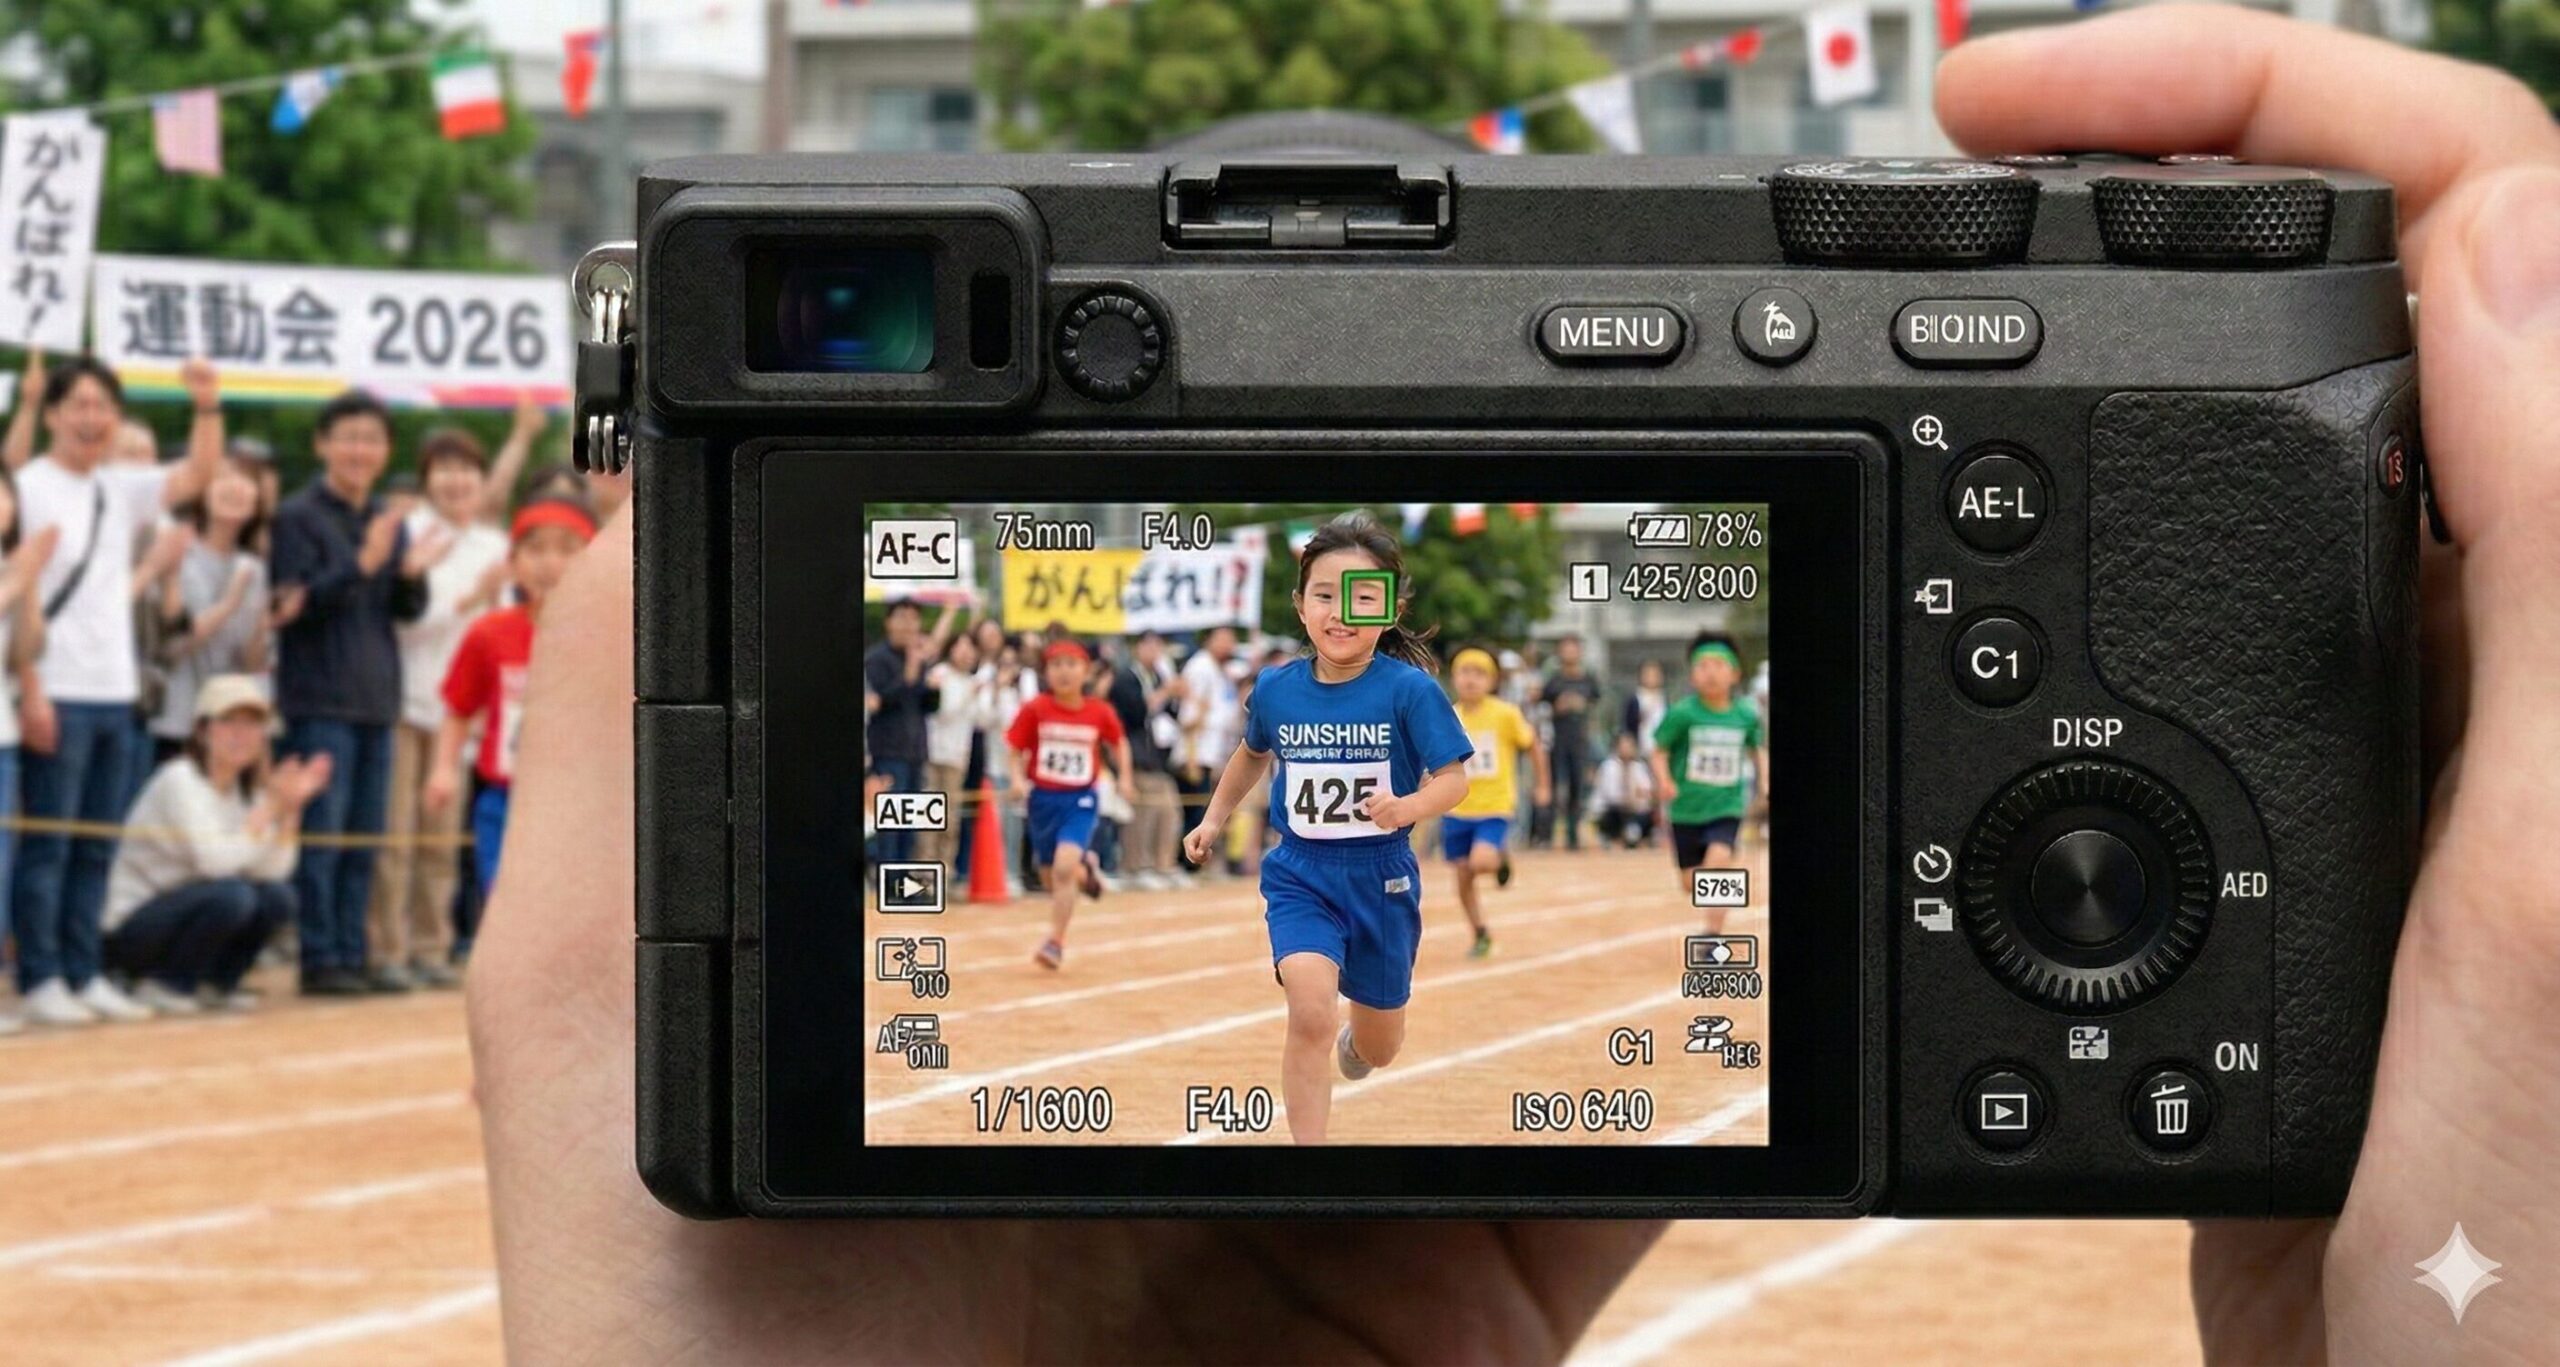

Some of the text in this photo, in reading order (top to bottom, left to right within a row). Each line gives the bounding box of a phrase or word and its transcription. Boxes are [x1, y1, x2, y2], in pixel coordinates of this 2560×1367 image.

[121, 278, 546, 369] 運動会 2026
[1560, 317, 1665, 347] MENU
[1958, 486, 2036, 519] AE-L
[994, 513, 1094, 549] 75mm
[1142, 513, 1213, 549] F4.0
[1697, 512, 1762, 548] 78%
[876, 532, 951, 565] AF-C
[1583, 564, 1758, 600] 1 425/800
[1971, 646, 2019, 680] C1
[1278, 722, 1392, 746] SUNSHINE
[2053, 718, 2123, 748] DISP
[879, 798, 944, 825] AE-C
[1293, 777, 1378, 824] 425
[1697, 878, 1744, 898] S78%
[2221, 872, 2268, 898] AED
[1609, 1028, 1653, 1065] C1
[2214, 1042, 2258, 1071] ON
[972, 1087, 1112, 1132] 1/1600
[1187, 1087, 1272, 1132] F4.0
[1514, 1088, 1653, 1131] ISO 640
